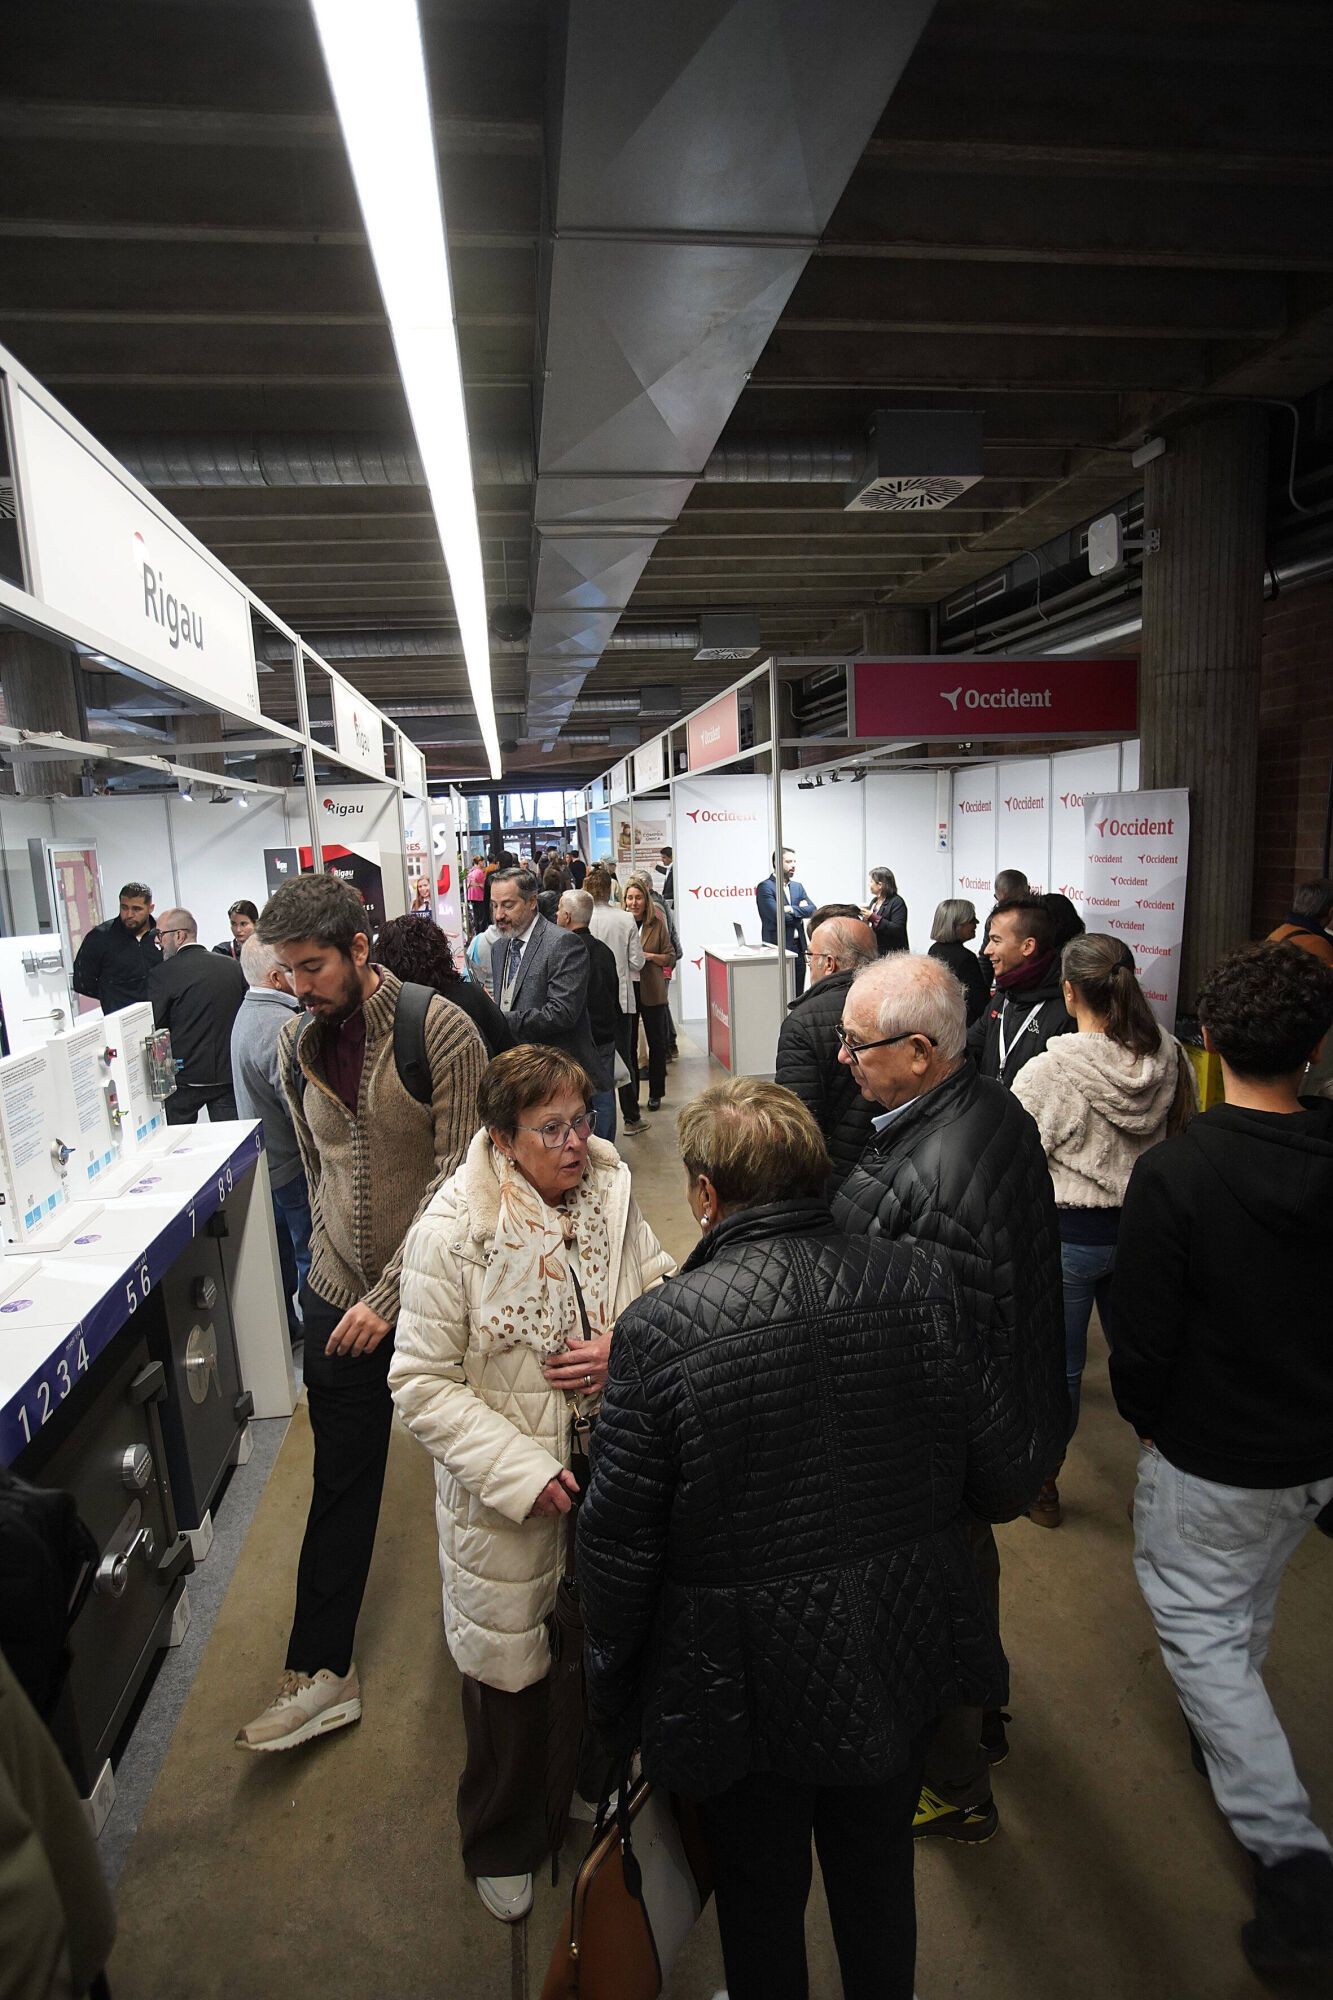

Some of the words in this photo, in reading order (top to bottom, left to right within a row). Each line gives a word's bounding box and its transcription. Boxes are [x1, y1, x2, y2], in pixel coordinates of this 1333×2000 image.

[143, 562, 204, 651] Rigau
[964, 688, 1052, 709] Occident
[327, 803, 364, 817] Rigau
[966, 799, 992, 813] Occident
[1012, 796, 1044, 810] Occident
[701, 810, 757, 822] Occident
[1109, 818, 1175, 836] Occident
[1094, 854, 1123, 864] Occident
[1145, 855, 1178, 865] Occident
[333, 869, 354, 879] Rigau
[965, 877, 991, 891] Occident
[1118, 877, 1148, 886] Occident
[1091, 898, 1121, 907] Occident
[1143, 900, 1175, 911] Occident
[1115, 920, 1145, 931] Occident
[1139, 945, 1172, 956] Occident
[255, 1134, 261, 1156] 9
[218, 1177, 225, 1203] 8
[226, 1168, 233, 1193] 9
[188, 1208, 196, 1239] 7
[126, 1279, 137, 1314] 5
[140, 1265, 151, 1298] 6
[18, 1405, 32, 1443] 1
[37, 1381, 54, 1425] 2
[56, 1359, 71, 1399] 3
[77, 1337, 90, 1372] 4
